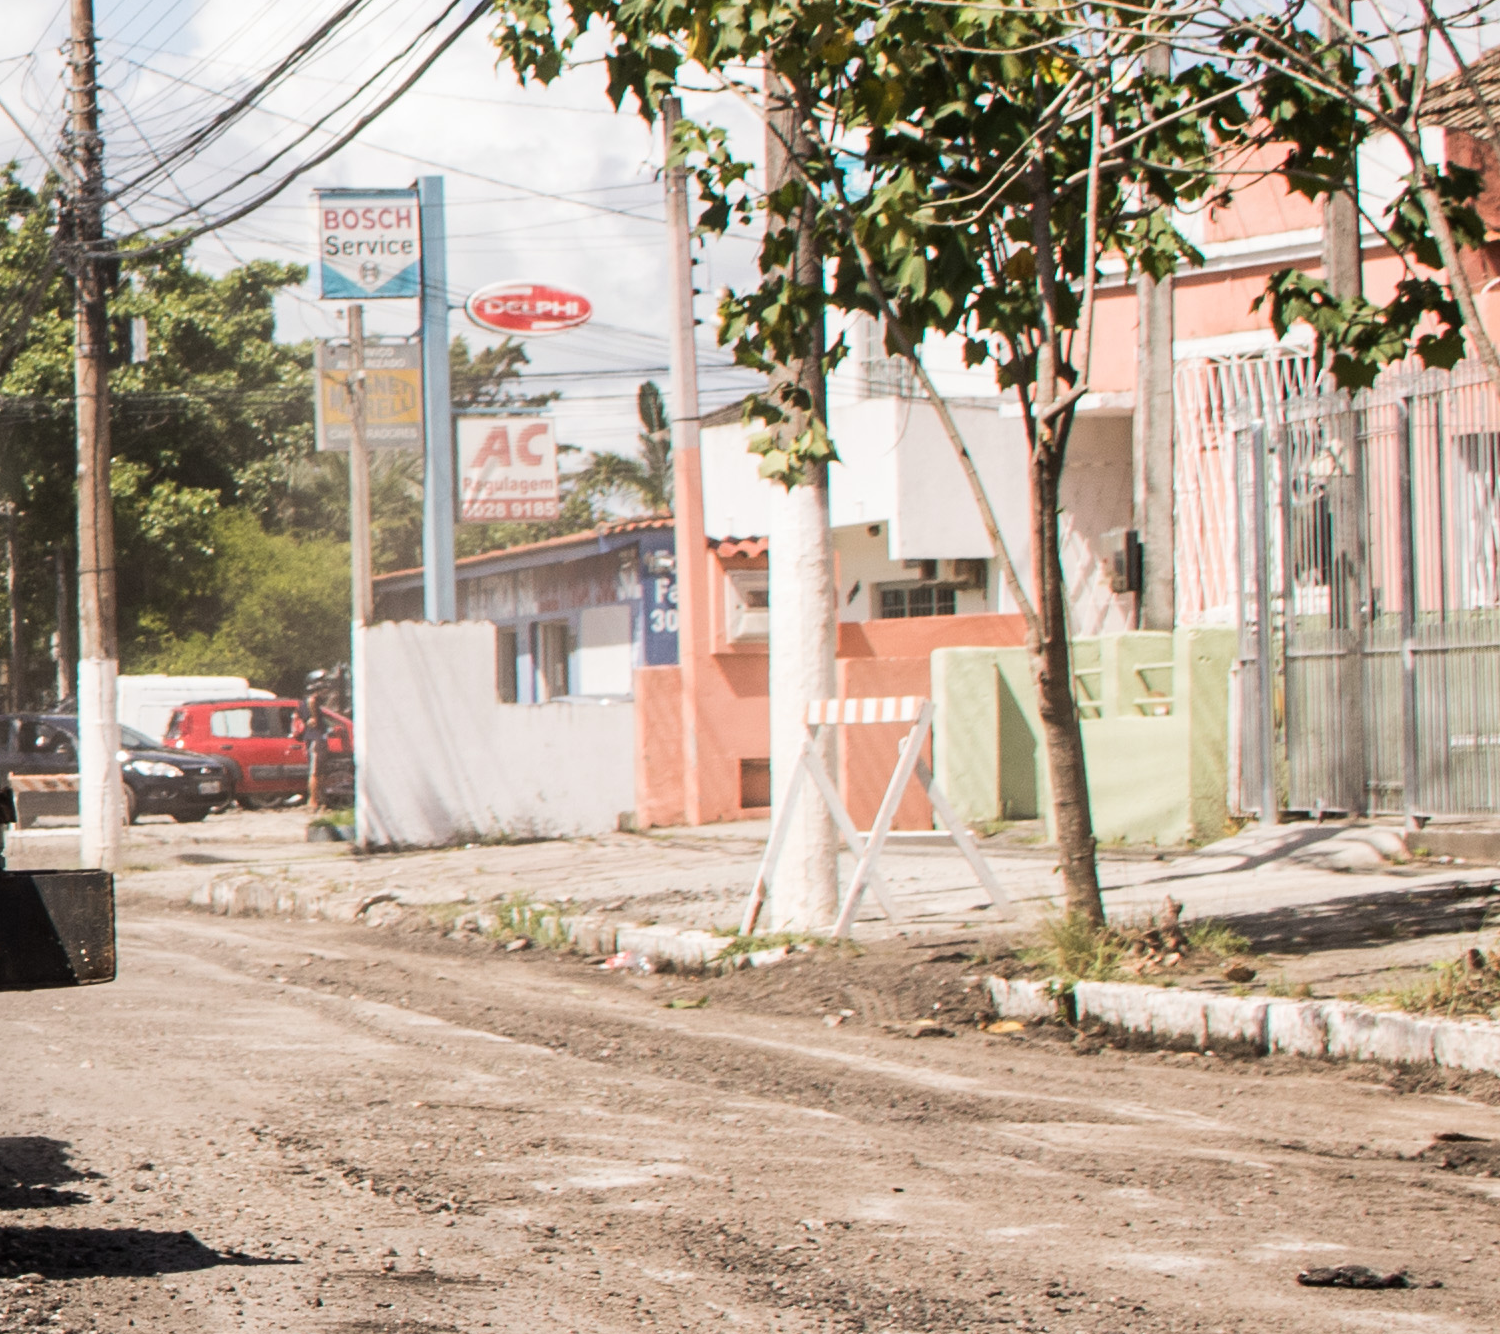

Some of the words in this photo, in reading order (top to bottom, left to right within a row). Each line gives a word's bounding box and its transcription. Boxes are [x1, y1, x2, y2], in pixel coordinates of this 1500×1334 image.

[323, 209, 412, 230] BOSCH
[325, 235, 414, 256] Service
[484, 300, 579, 316] DELPHI
[471, 423, 549, 467] AC
[463, 476, 553, 496] Regulagem
[510, 500, 556, 518] 9185
